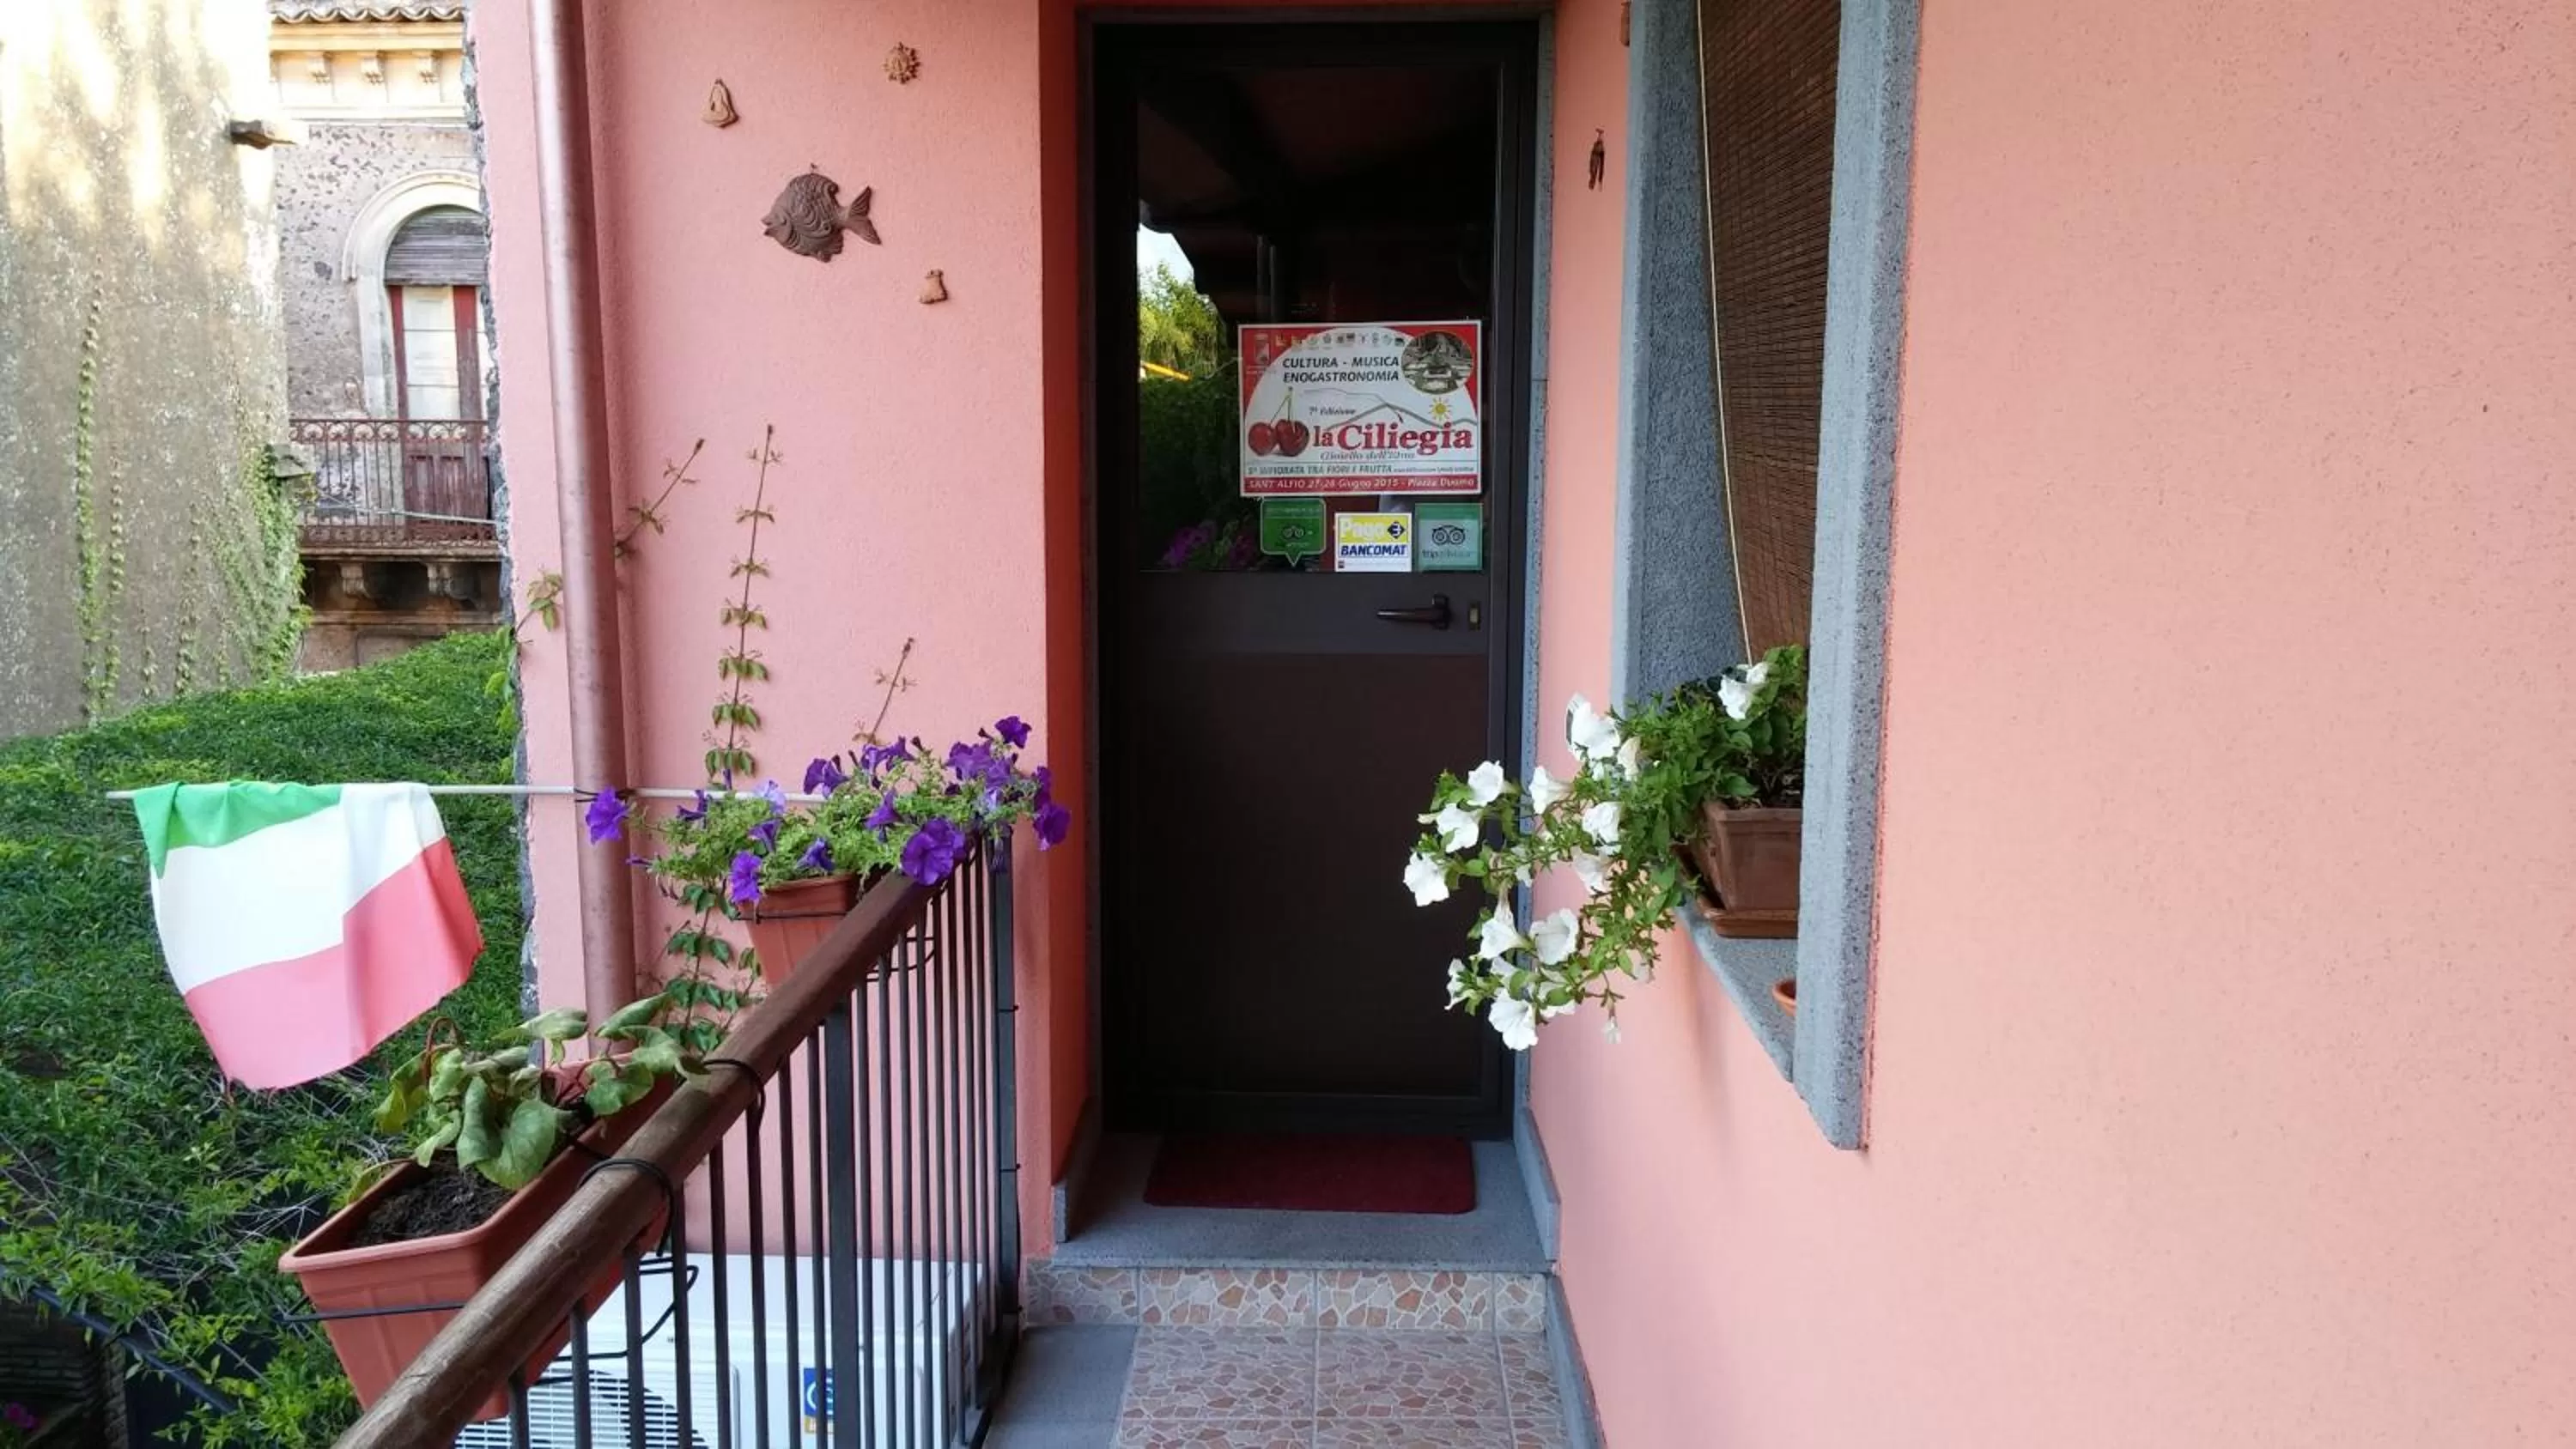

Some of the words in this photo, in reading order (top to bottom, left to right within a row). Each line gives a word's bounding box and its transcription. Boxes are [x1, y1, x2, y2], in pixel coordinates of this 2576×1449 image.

[1283, 357, 1339, 368] CULTURA
[1352, 356, 1400, 367] MUSICA
[1283, 371, 1400, 383] ENOGASTRONOMIA
[1313, 425, 1334, 447] la
[1338, 421, 1474, 455] Ciliegia
[1339, 478, 1372, 490] Giugno
[1340, 517, 1385, 540] Pago
[1340, 544, 1406, 557] BANCOMAT
